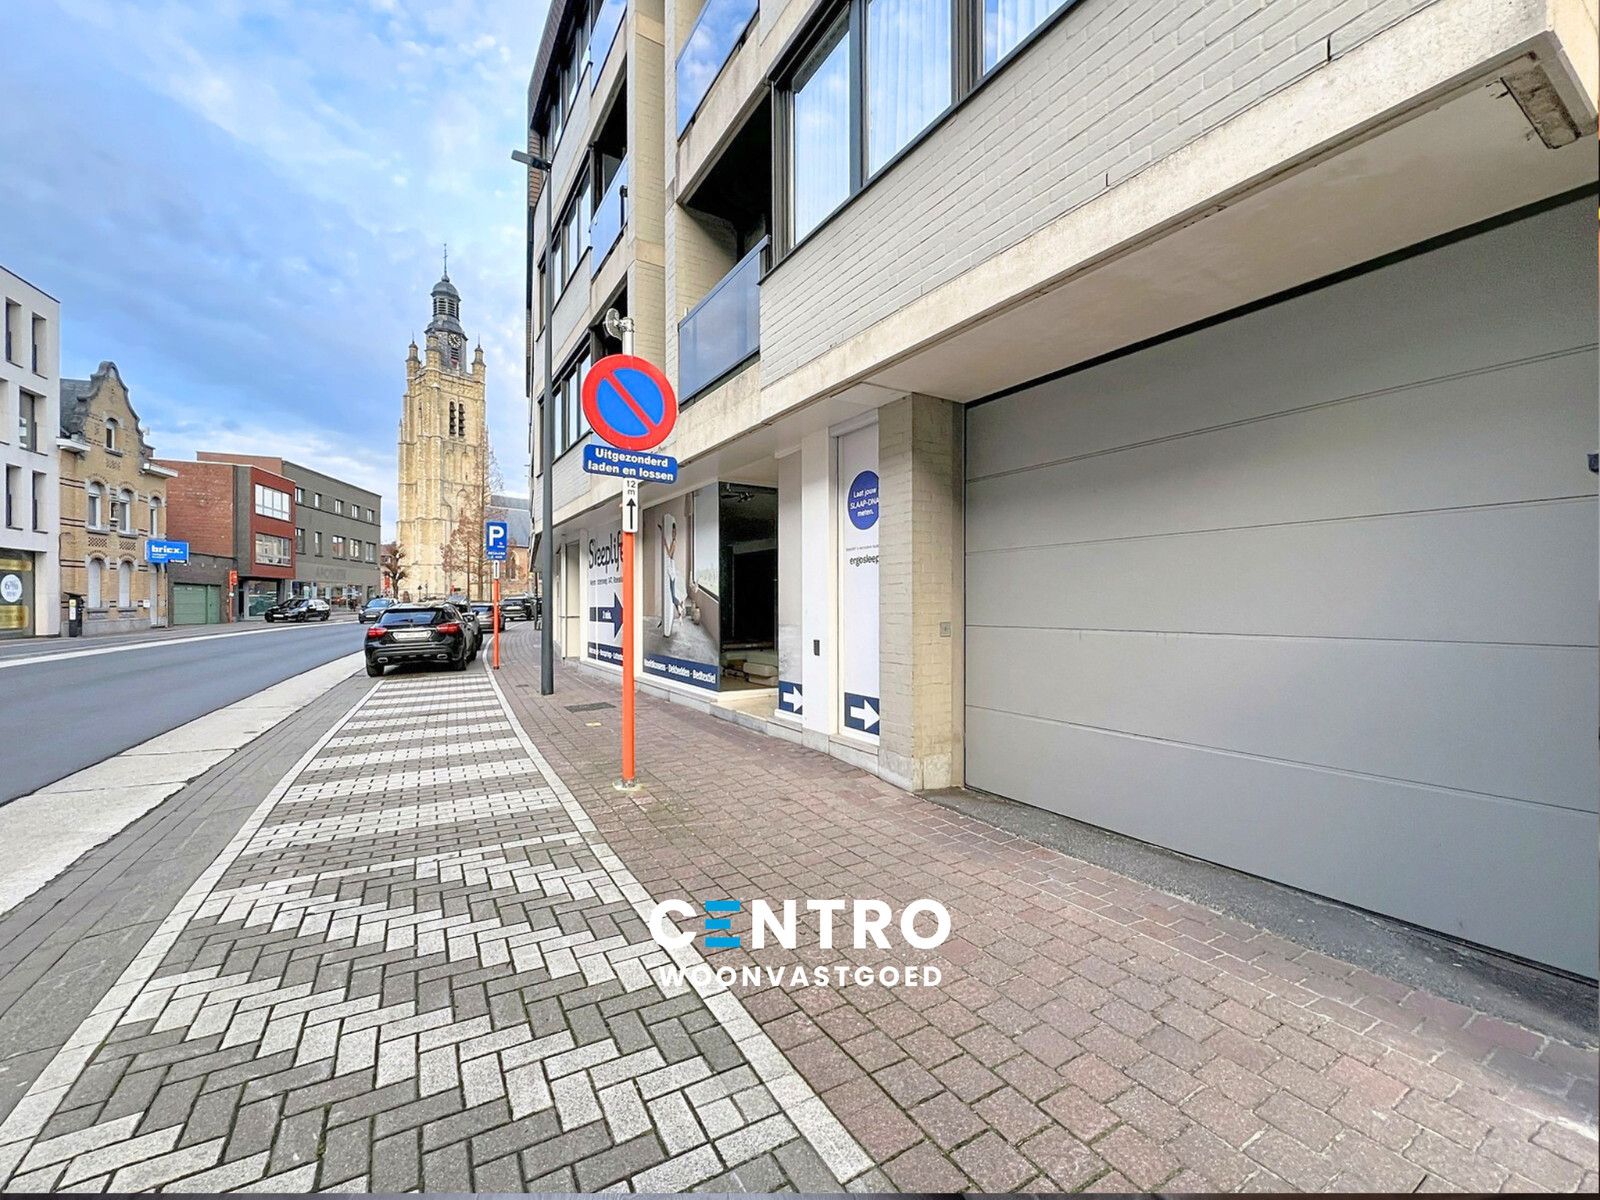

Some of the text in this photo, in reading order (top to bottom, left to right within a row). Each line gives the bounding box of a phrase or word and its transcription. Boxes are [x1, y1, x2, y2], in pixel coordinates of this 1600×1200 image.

[595, 447, 668, 467] Uitgezonderd
[588, 460, 619, 473] laden
[640, 468, 673, 481] lossen
[627, 480, 636, 488] 12
[865, 488, 877, 496] jouw
[489, 525, 504, 546] P
